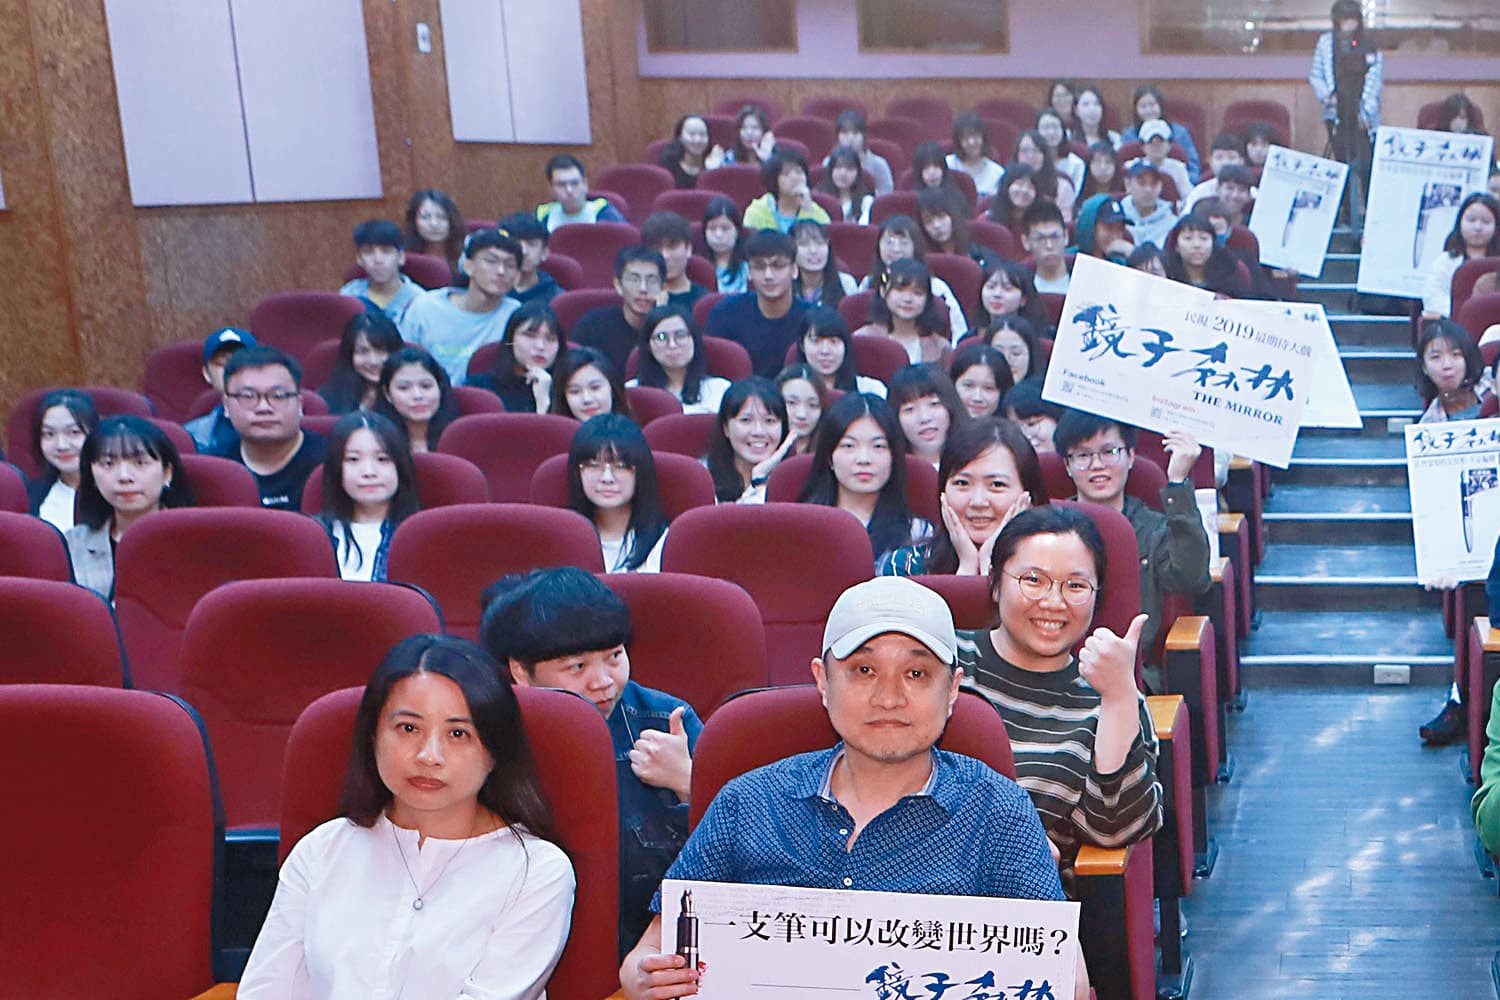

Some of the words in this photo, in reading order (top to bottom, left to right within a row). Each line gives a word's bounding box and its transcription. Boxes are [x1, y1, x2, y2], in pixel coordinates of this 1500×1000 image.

[1212, 315, 1255, 341] 2019
[1072, 303, 1294, 401] 鏡子森林
[1062, 368, 1106, 387] Facebook
[1192, 390, 1222, 407] THE
[1225, 400, 1284, 425] MIRROR
